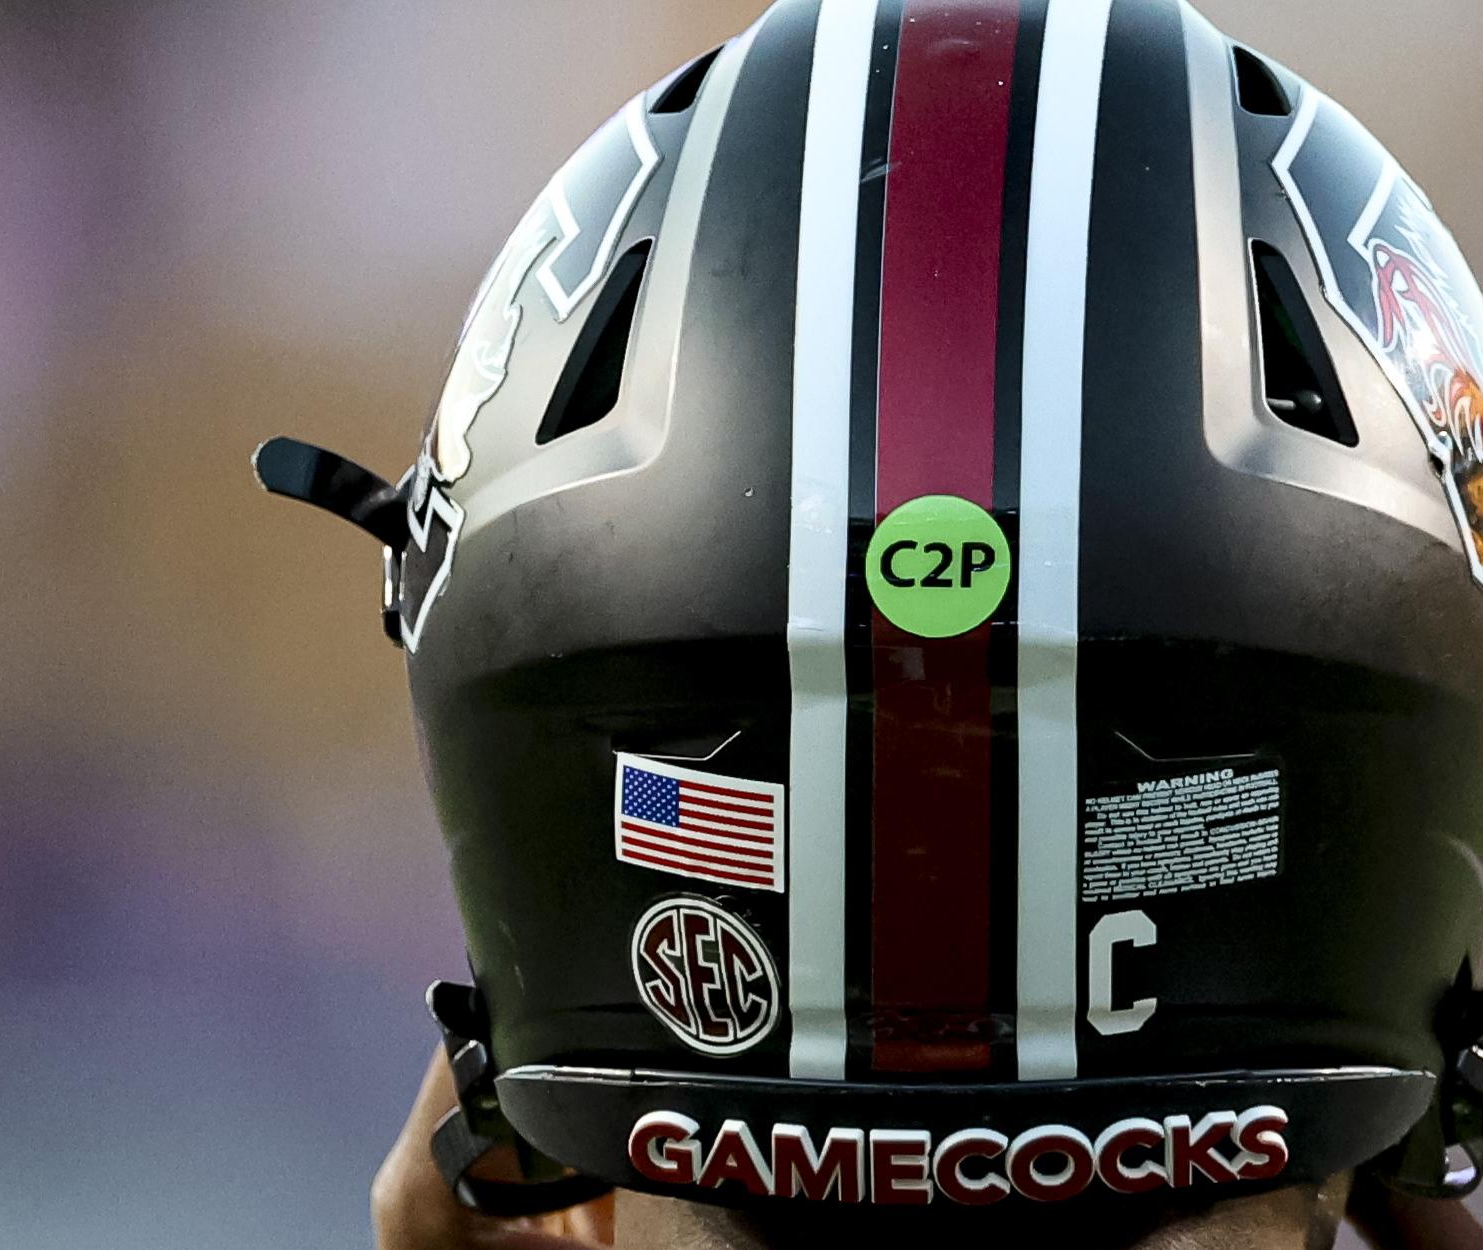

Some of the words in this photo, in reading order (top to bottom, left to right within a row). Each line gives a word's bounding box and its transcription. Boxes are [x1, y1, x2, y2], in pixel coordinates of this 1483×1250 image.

[880, 540, 995, 588] C2P
[1137, 768, 1234, 793] WARNING
[639, 909, 769, 1042] SEC
[1088, 910, 1157, 1035] C
[628, 1105, 1289, 1203] GAMECOCKS
